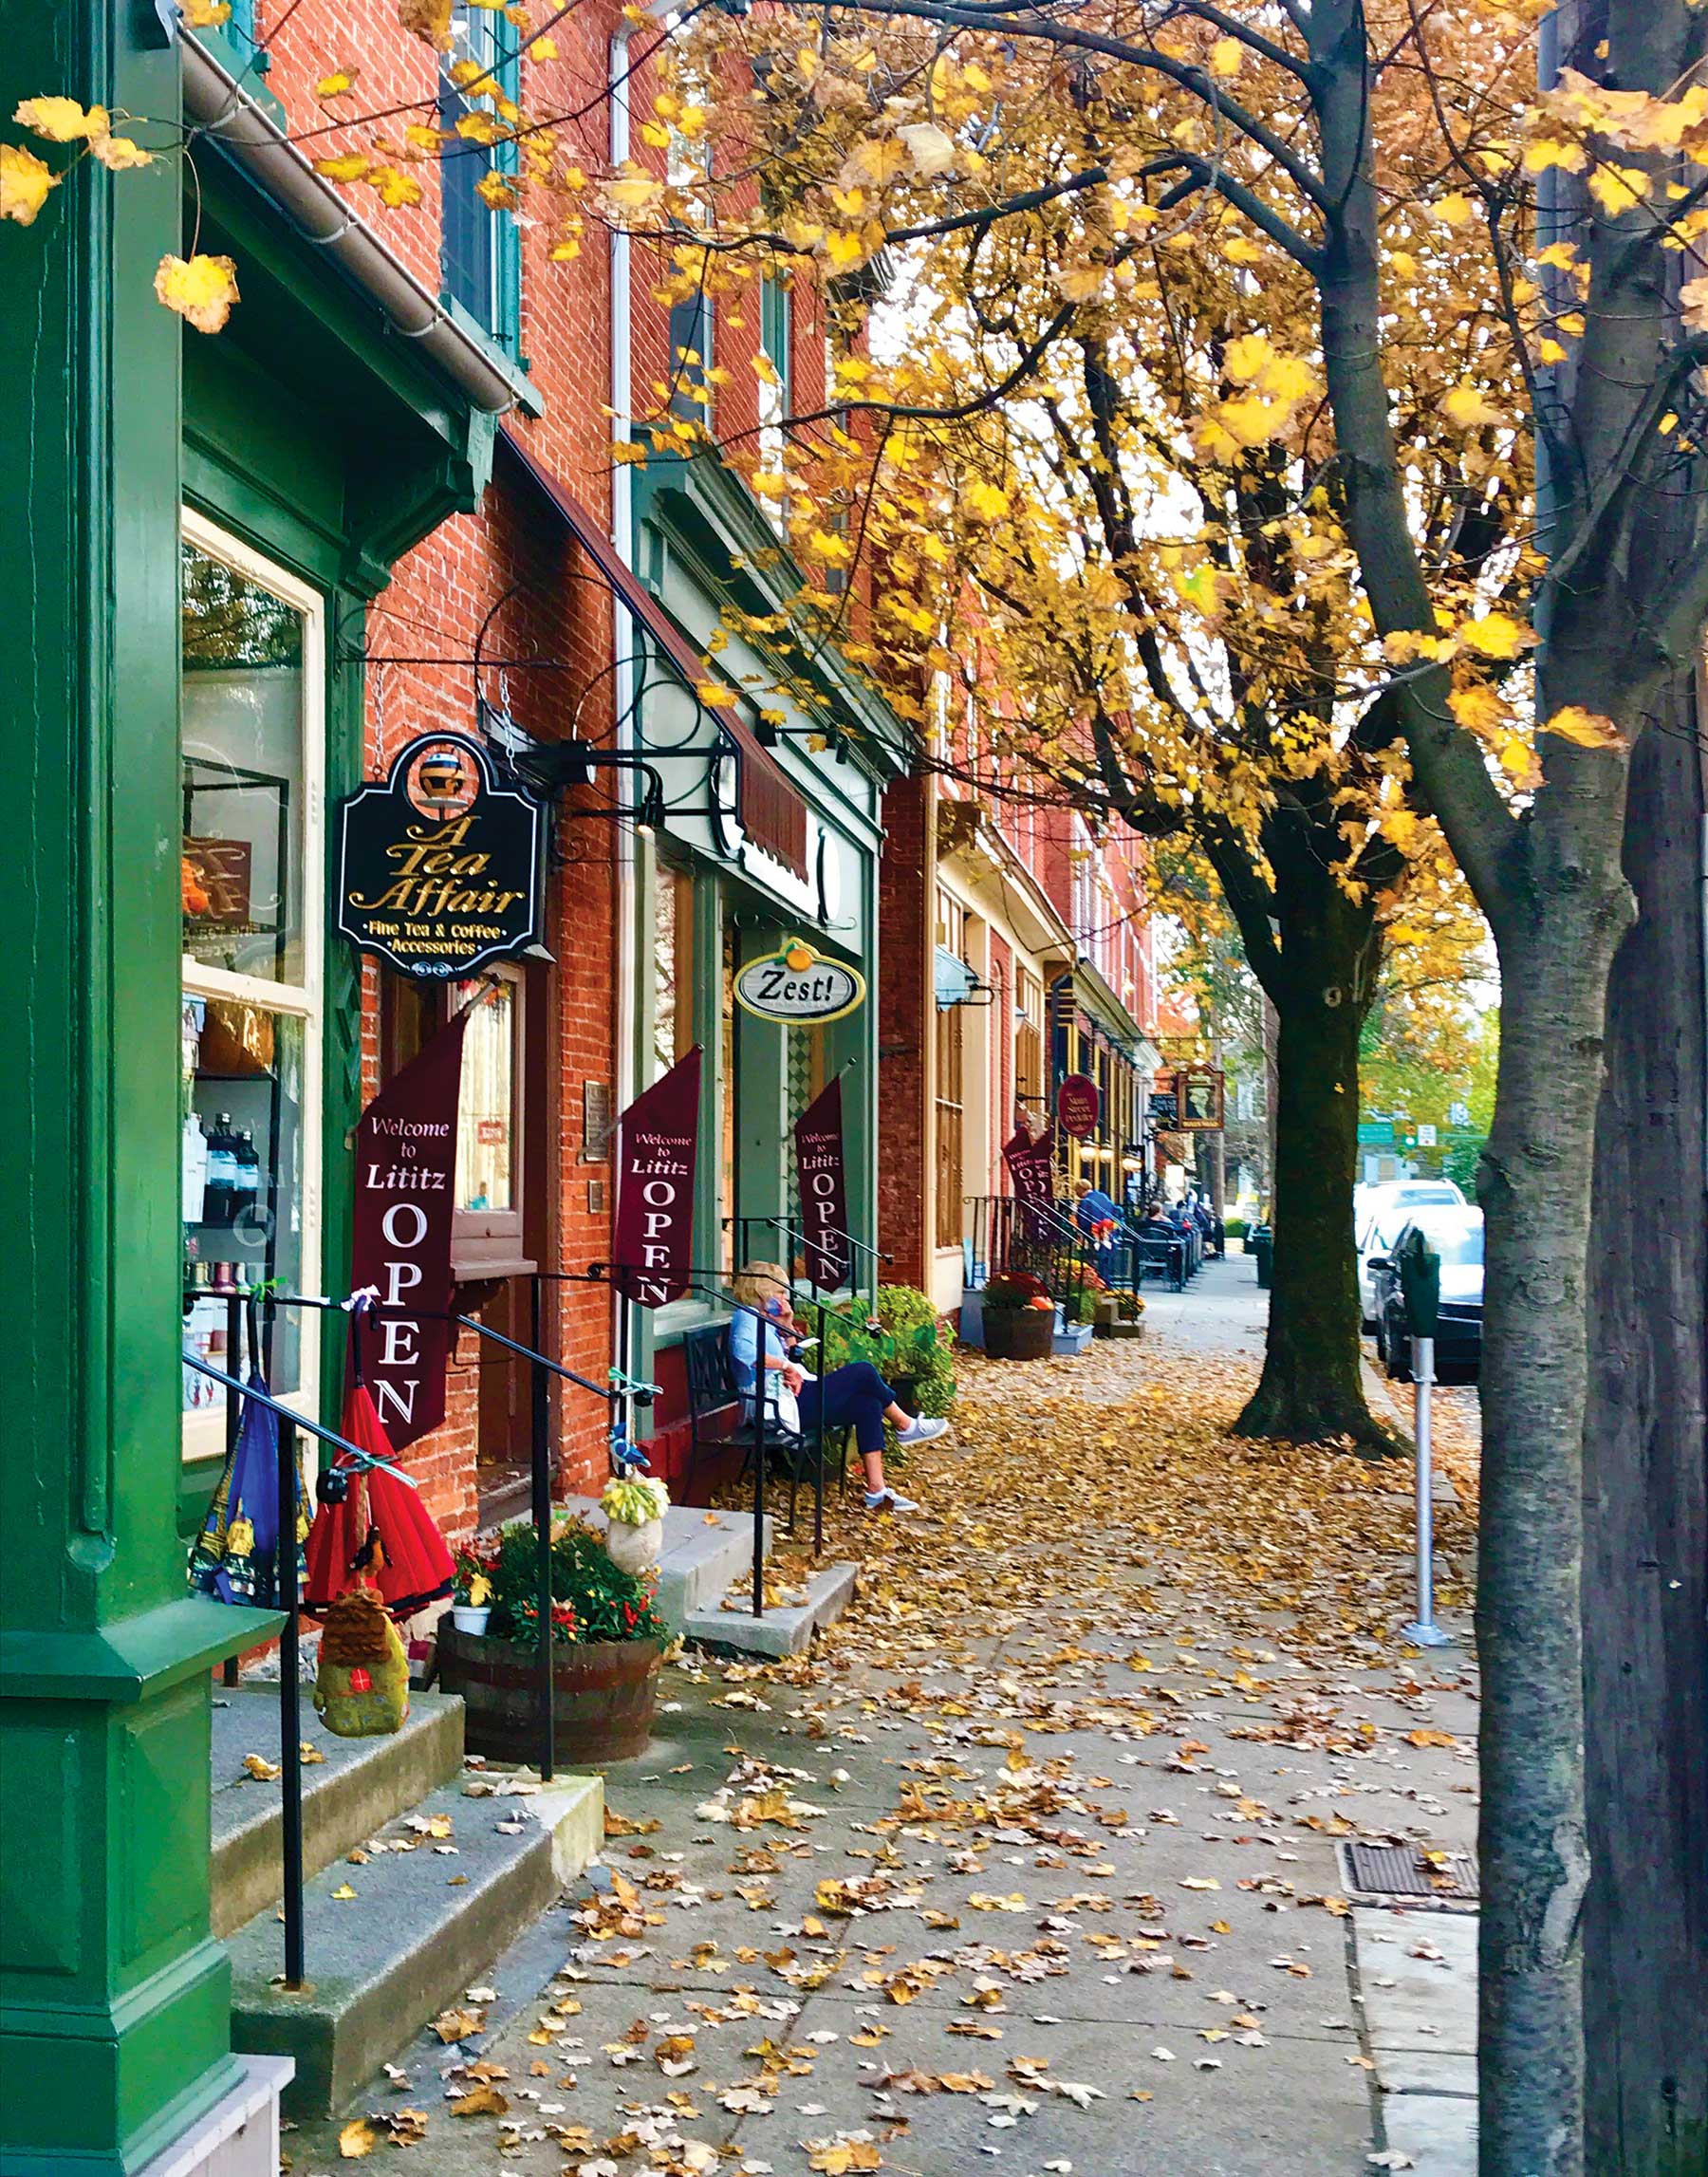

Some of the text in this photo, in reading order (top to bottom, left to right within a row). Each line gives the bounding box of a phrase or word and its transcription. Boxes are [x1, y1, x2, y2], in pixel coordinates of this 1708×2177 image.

[406, 815, 481, 847] A
[386, 843, 492, 876] Tea
[348, 877, 526, 917] Affair
[368, 921, 500, 940] Fine Tea & Coffee
[391, 940, 476, 956] Accessories
[757, 970, 833, 1001] Zest!
[371, 1116, 450, 1139] Welcome
[636, 1133, 692, 1146] Welcome
[400, 1142, 417, 1160] to
[657, 1146, 671, 1157] to
[803, 1154, 840, 1170] Lititz
[366, 1163, 447, 1190] Lititz
[630, 1158, 688, 1176] Lititz
[812, 1173, 840, 1280] OPEN
[637, 1181, 676, 1303] OPEN
[373, 1203, 429, 1424] OPEN
